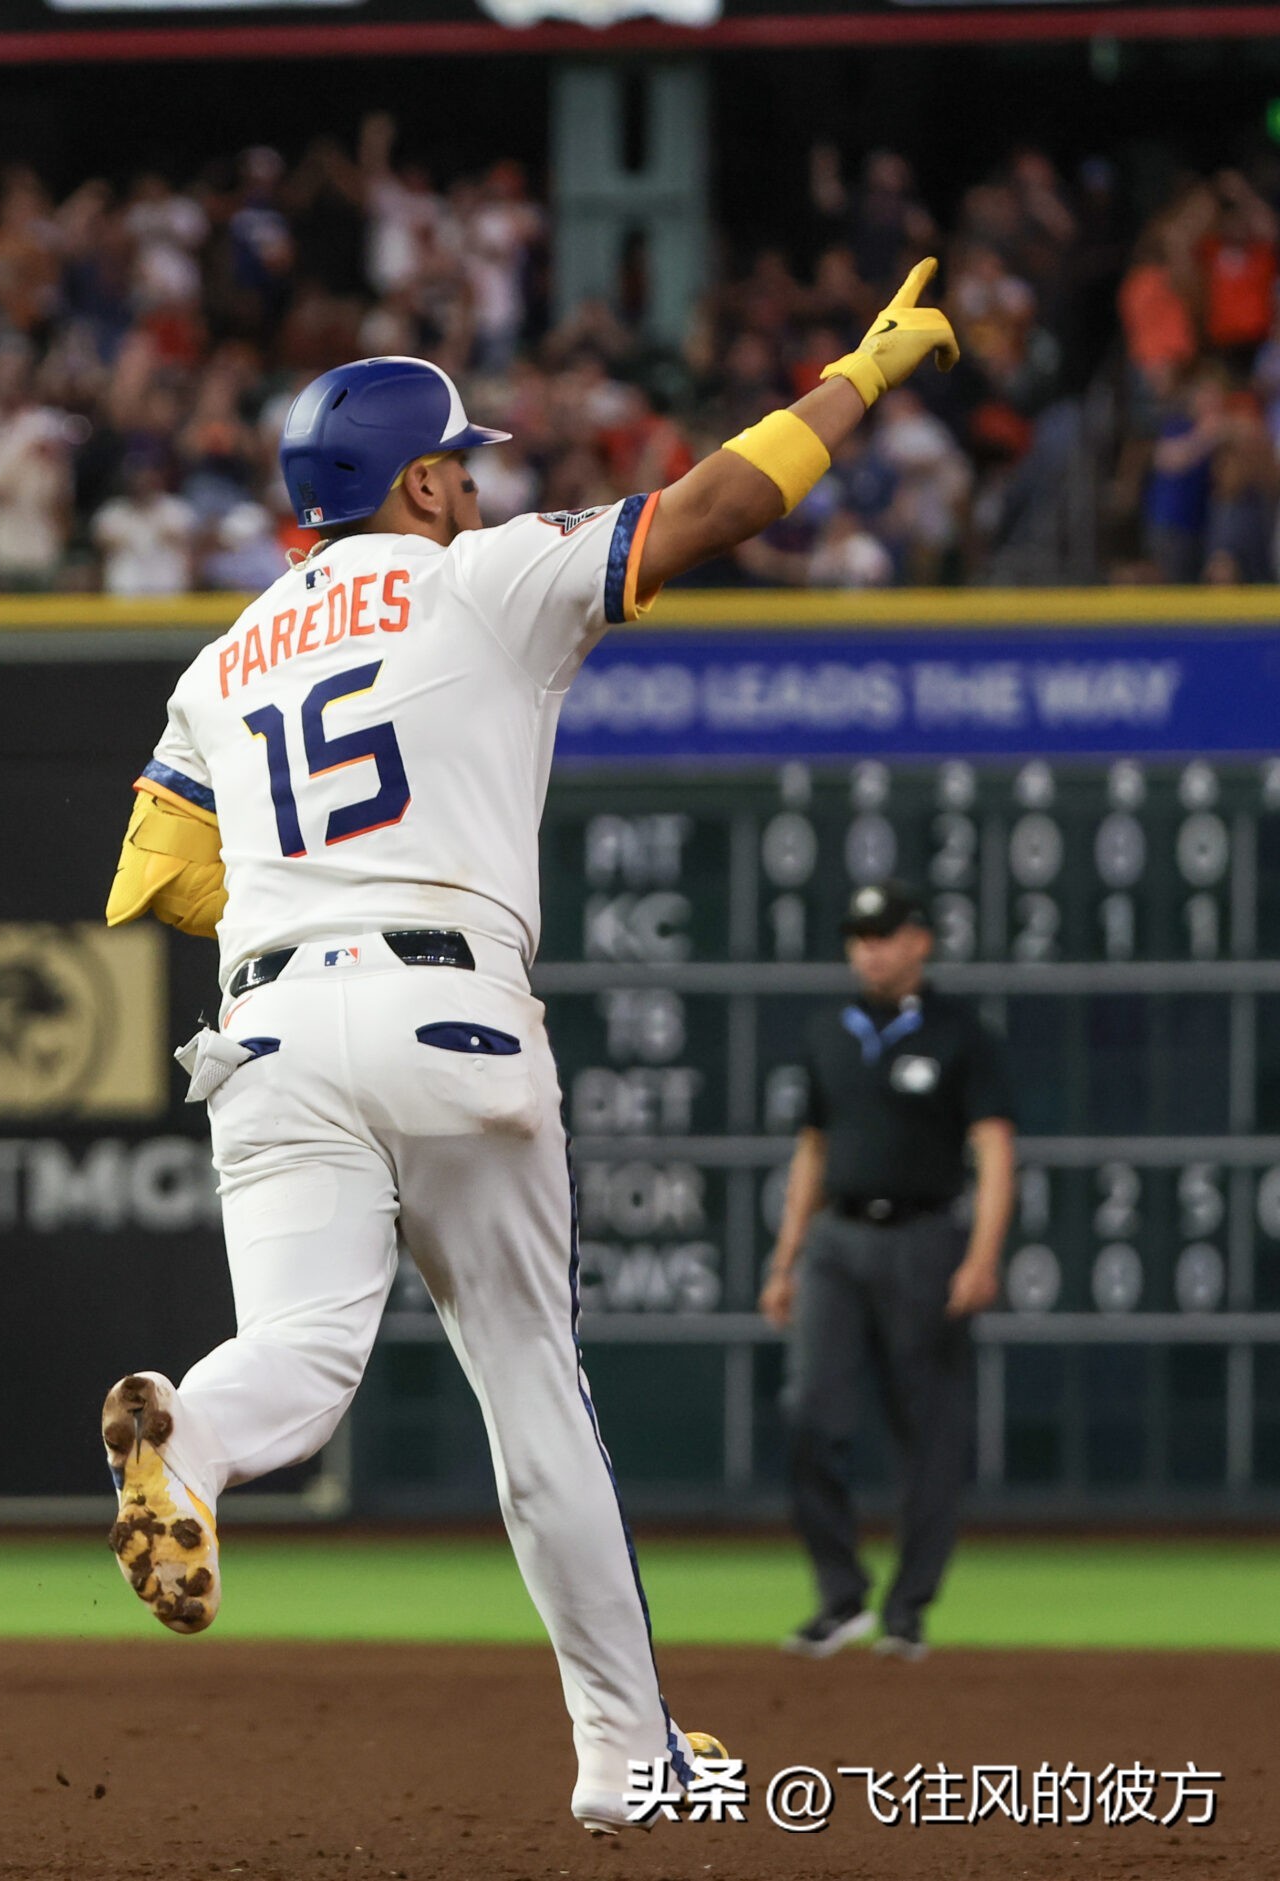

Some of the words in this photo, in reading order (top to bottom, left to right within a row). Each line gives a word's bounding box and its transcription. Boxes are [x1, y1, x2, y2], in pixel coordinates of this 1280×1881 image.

[219, 569, 410, 699] PAREDES
[703, 661, 906, 731] LEADS
[912, 660, 1022, 728] THE
[1029, 658, 1182, 727] WAY
[242, 658, 412, 858] 15
[585, 893, 692, 964] KC
[572, 1066, 700, 1136] DET
